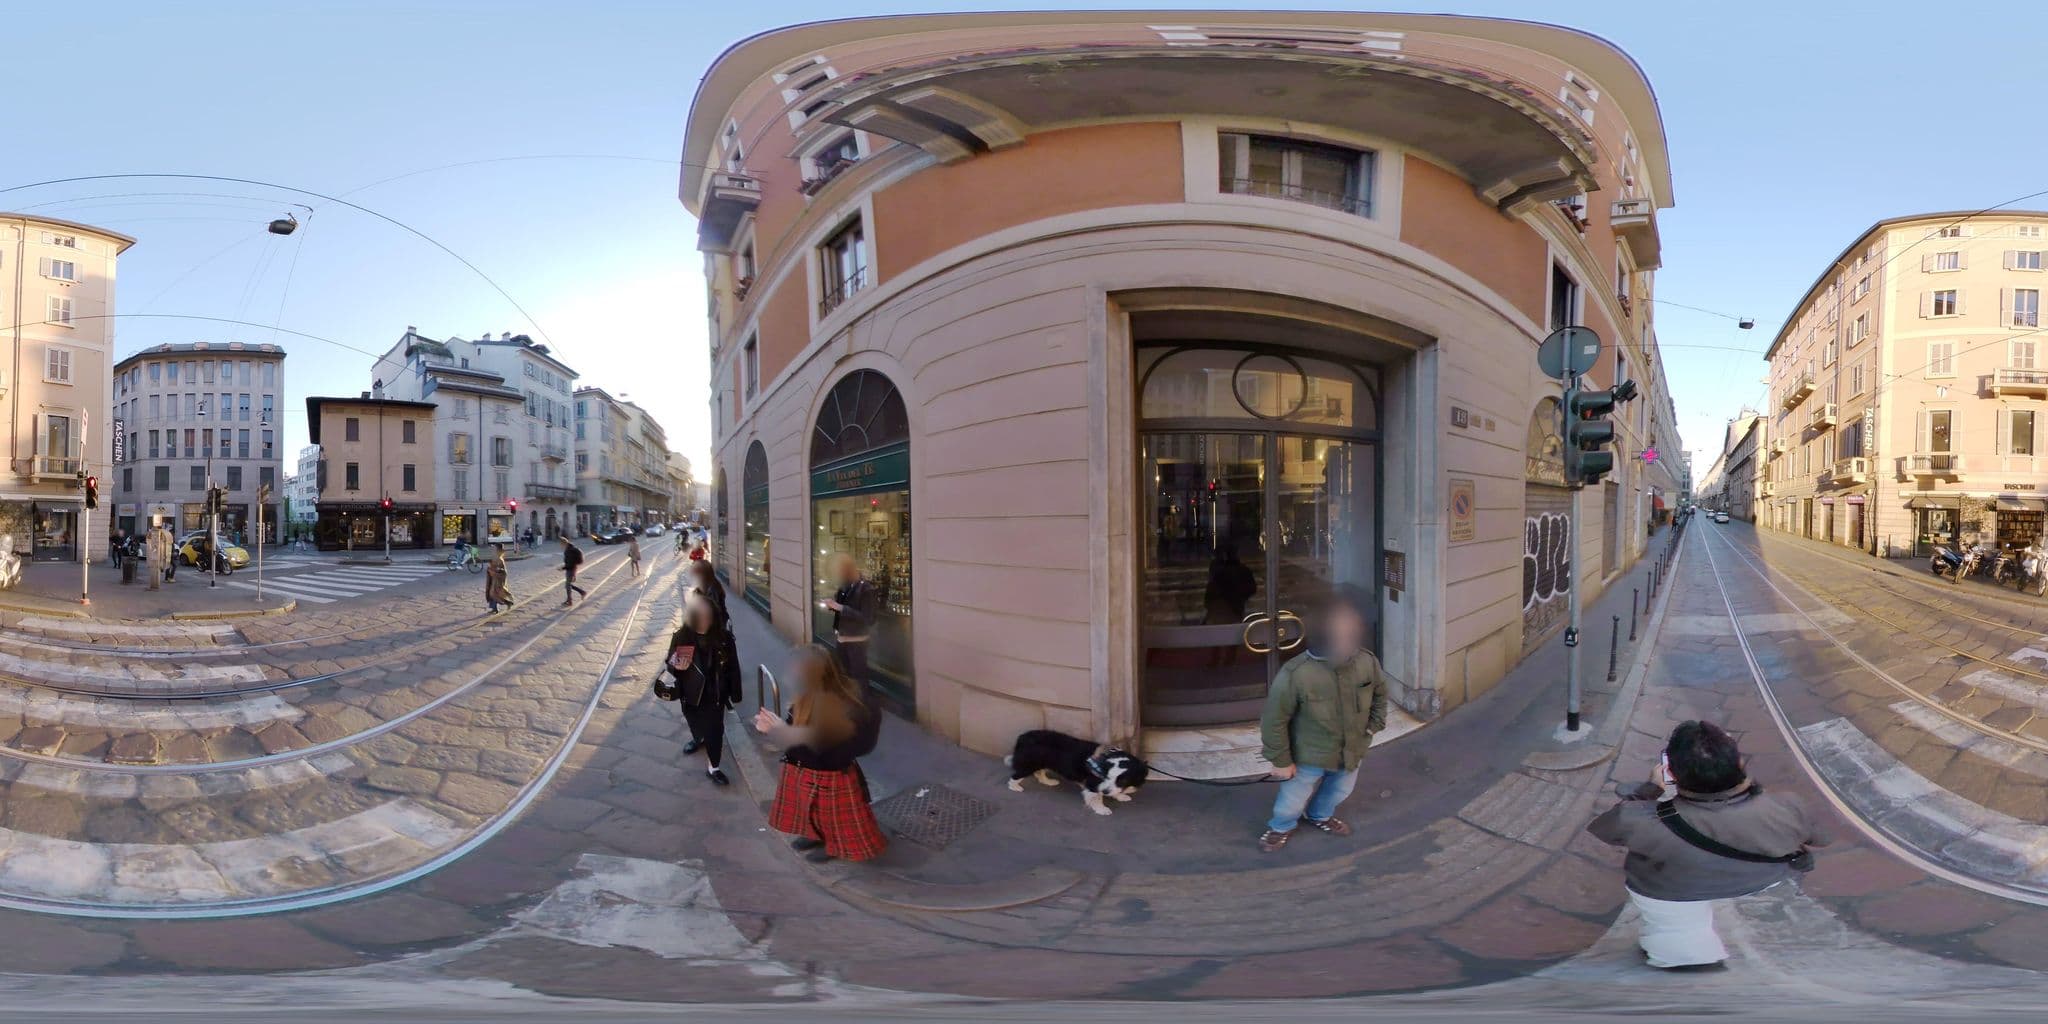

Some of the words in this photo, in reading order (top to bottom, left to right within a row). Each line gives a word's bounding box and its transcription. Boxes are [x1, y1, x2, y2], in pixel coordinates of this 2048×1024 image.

[115, 421, 123, 462] TASCHEN
[1865, 407, 1874, 450] TASCHEN
[2004, 483, 2036, 491] TASCHEN
